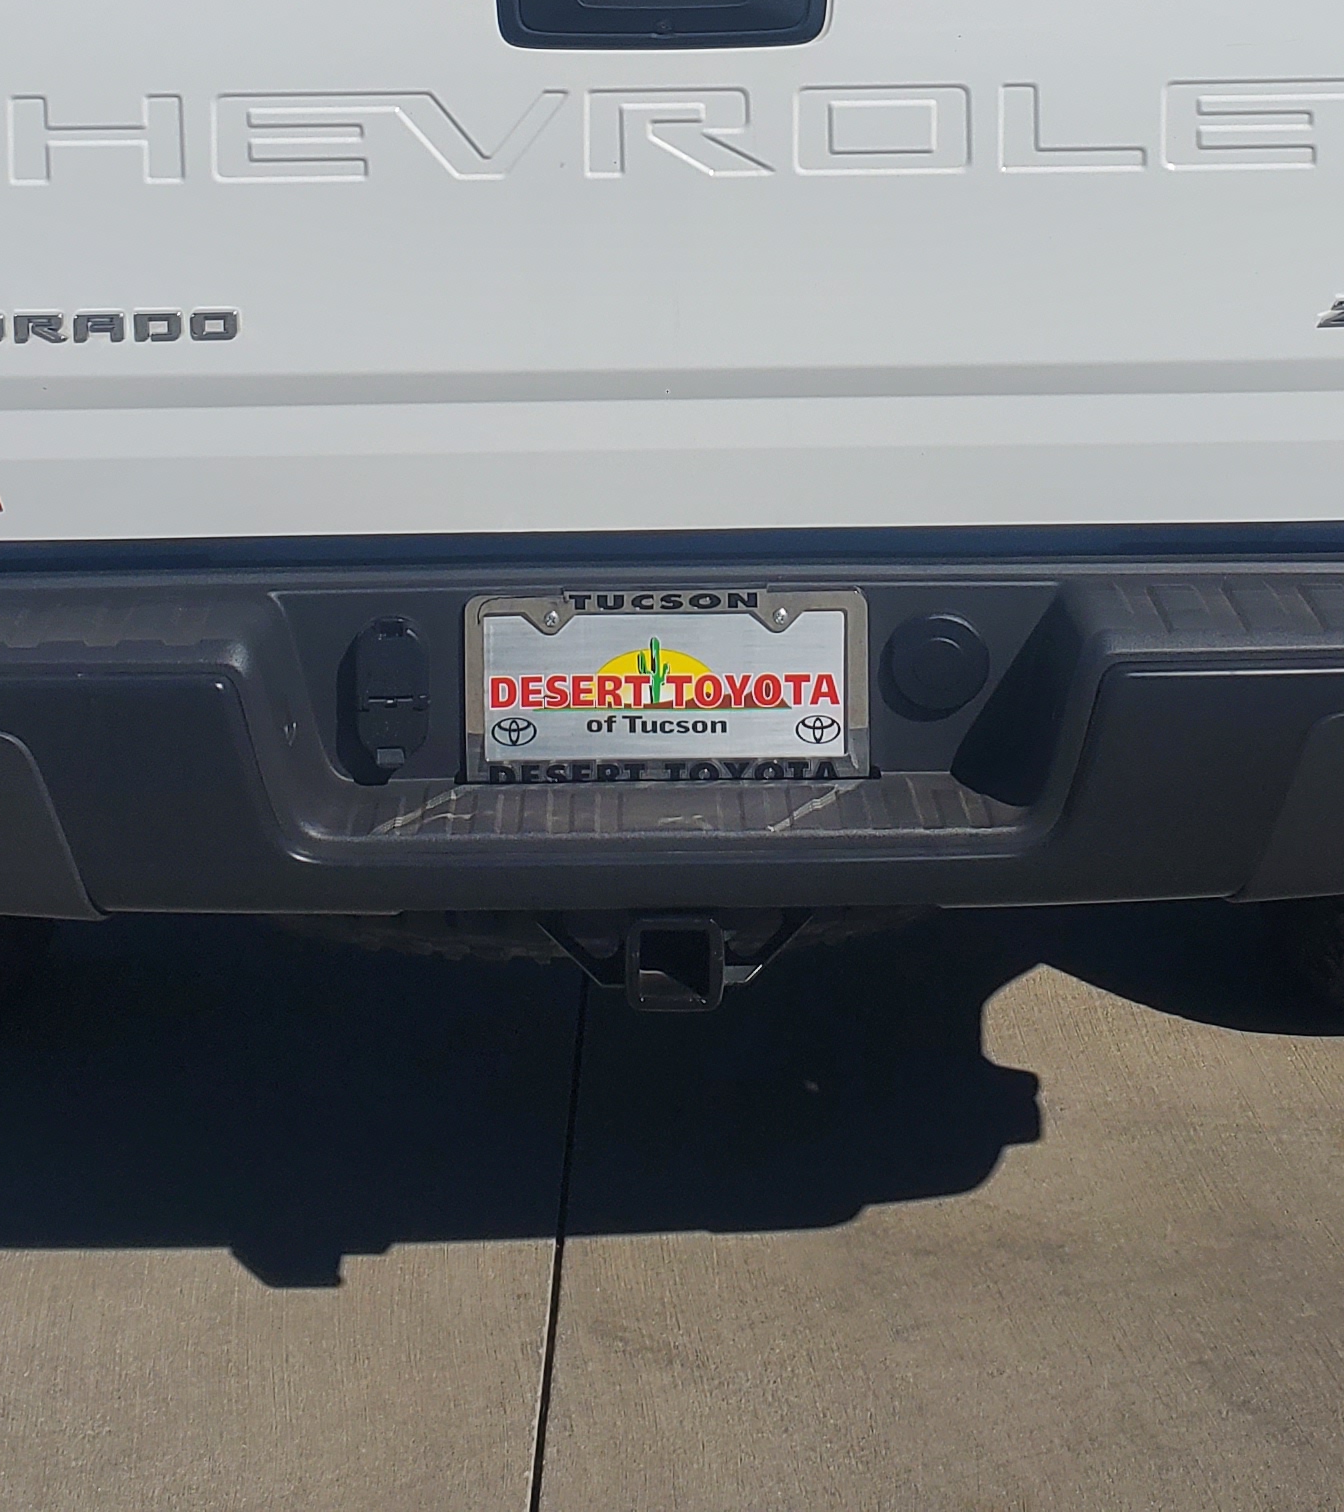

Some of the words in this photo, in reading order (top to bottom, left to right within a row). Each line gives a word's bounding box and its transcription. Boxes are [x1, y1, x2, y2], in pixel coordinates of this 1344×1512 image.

[568, 592, 758, 610] TUCSON
[489, 674, 651, 709] DESERT
[664, 673, 841, 707] TOYOTA
[586, 714, 617, 734] of
[621, 715, 728, 734] Tucson
[489, 763, 650, 781] DESERT
[665, 761, 839, 780] TOYOTA
